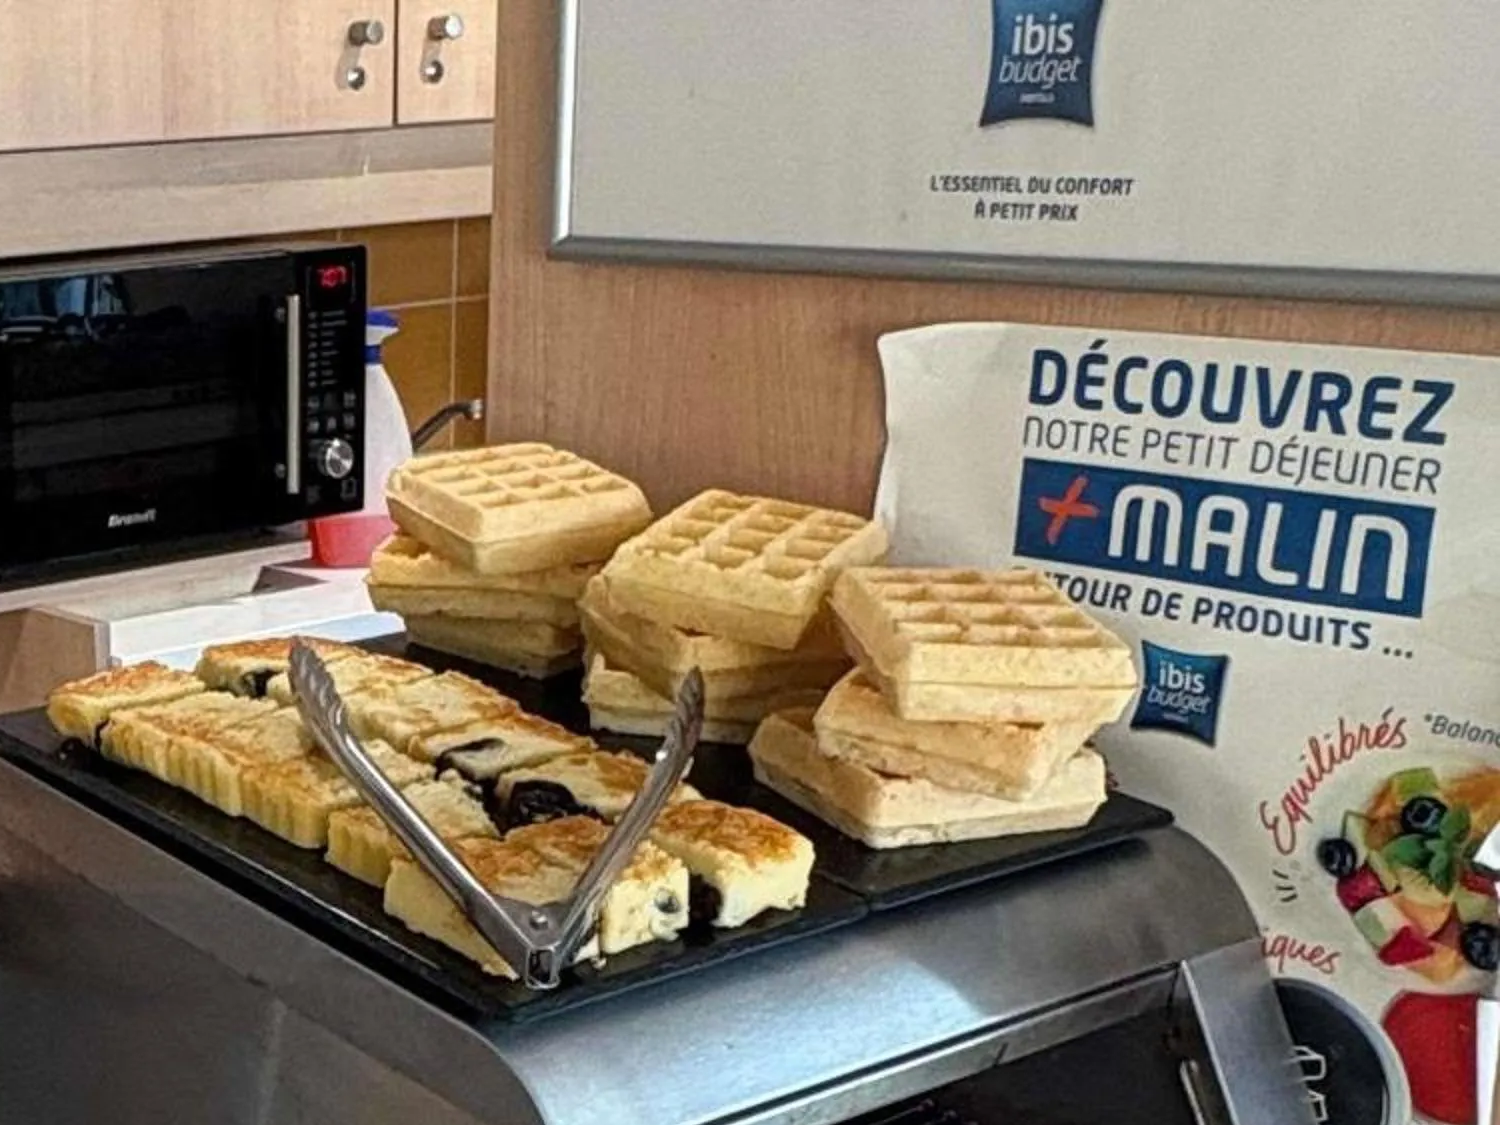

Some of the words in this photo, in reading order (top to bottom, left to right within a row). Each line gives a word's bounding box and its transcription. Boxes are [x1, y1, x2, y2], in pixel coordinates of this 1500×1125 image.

[1011, 12, 1075, 55] ibis
[999, 54, 1082, 90] budget
[930, 175, 1023, 194] L'ESSENTIEL
[1027, 177, 1051, 195] DU
[1055, 177, 1135, 197] CONFORT
[974, 198, 987, 219] À
[990, 201, 1036, 221] PETIT
[1038, 203, 1079, 222] PRIX
[1028, 339, 1455, 447] DÉCOUVREZ
[1023, 415, 1131, 458] NOTRE
[1140, 428, 1240, 470] PETIT
[1249, 434, 1442, 495] DÉJEUNER
[1107, 483, 1410, 601] MALIN
[1012, 566, 1132, 612] TOUR
[1141, 587, 1184, 621] DE
[1191, 596, 1373, 651] PRODUITS
[1159, 660, 1205, 695] ibis
[1147, 685, 1211, 715] budget
[1260, 706, 1407, 857] Equilibrés
